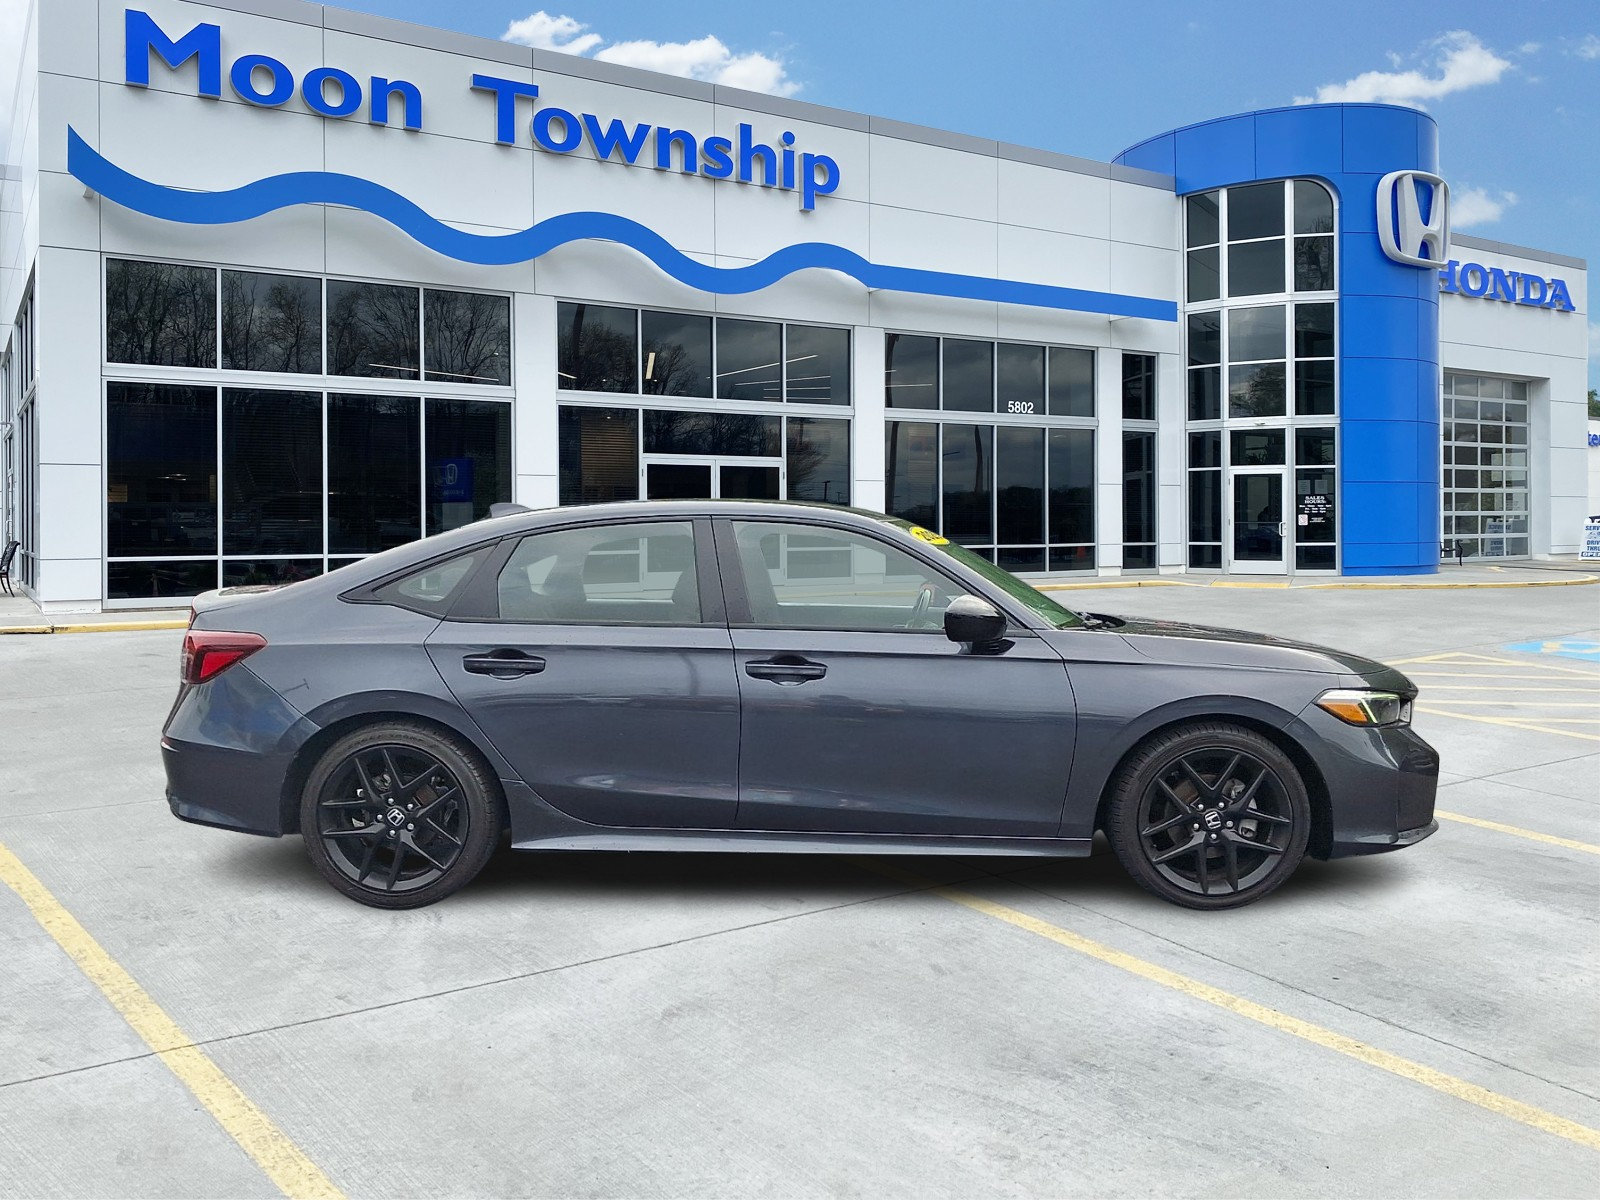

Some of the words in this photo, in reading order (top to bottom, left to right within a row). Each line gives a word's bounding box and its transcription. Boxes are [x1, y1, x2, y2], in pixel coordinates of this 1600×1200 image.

[125, 9, 422, 131] Moon
[469, 73, 841, 212] Township
[1438, 259, 1576, 312] HONDA
[1008, 401, 1034, 414] 5802
[1588, 431, 1600, 447] te
